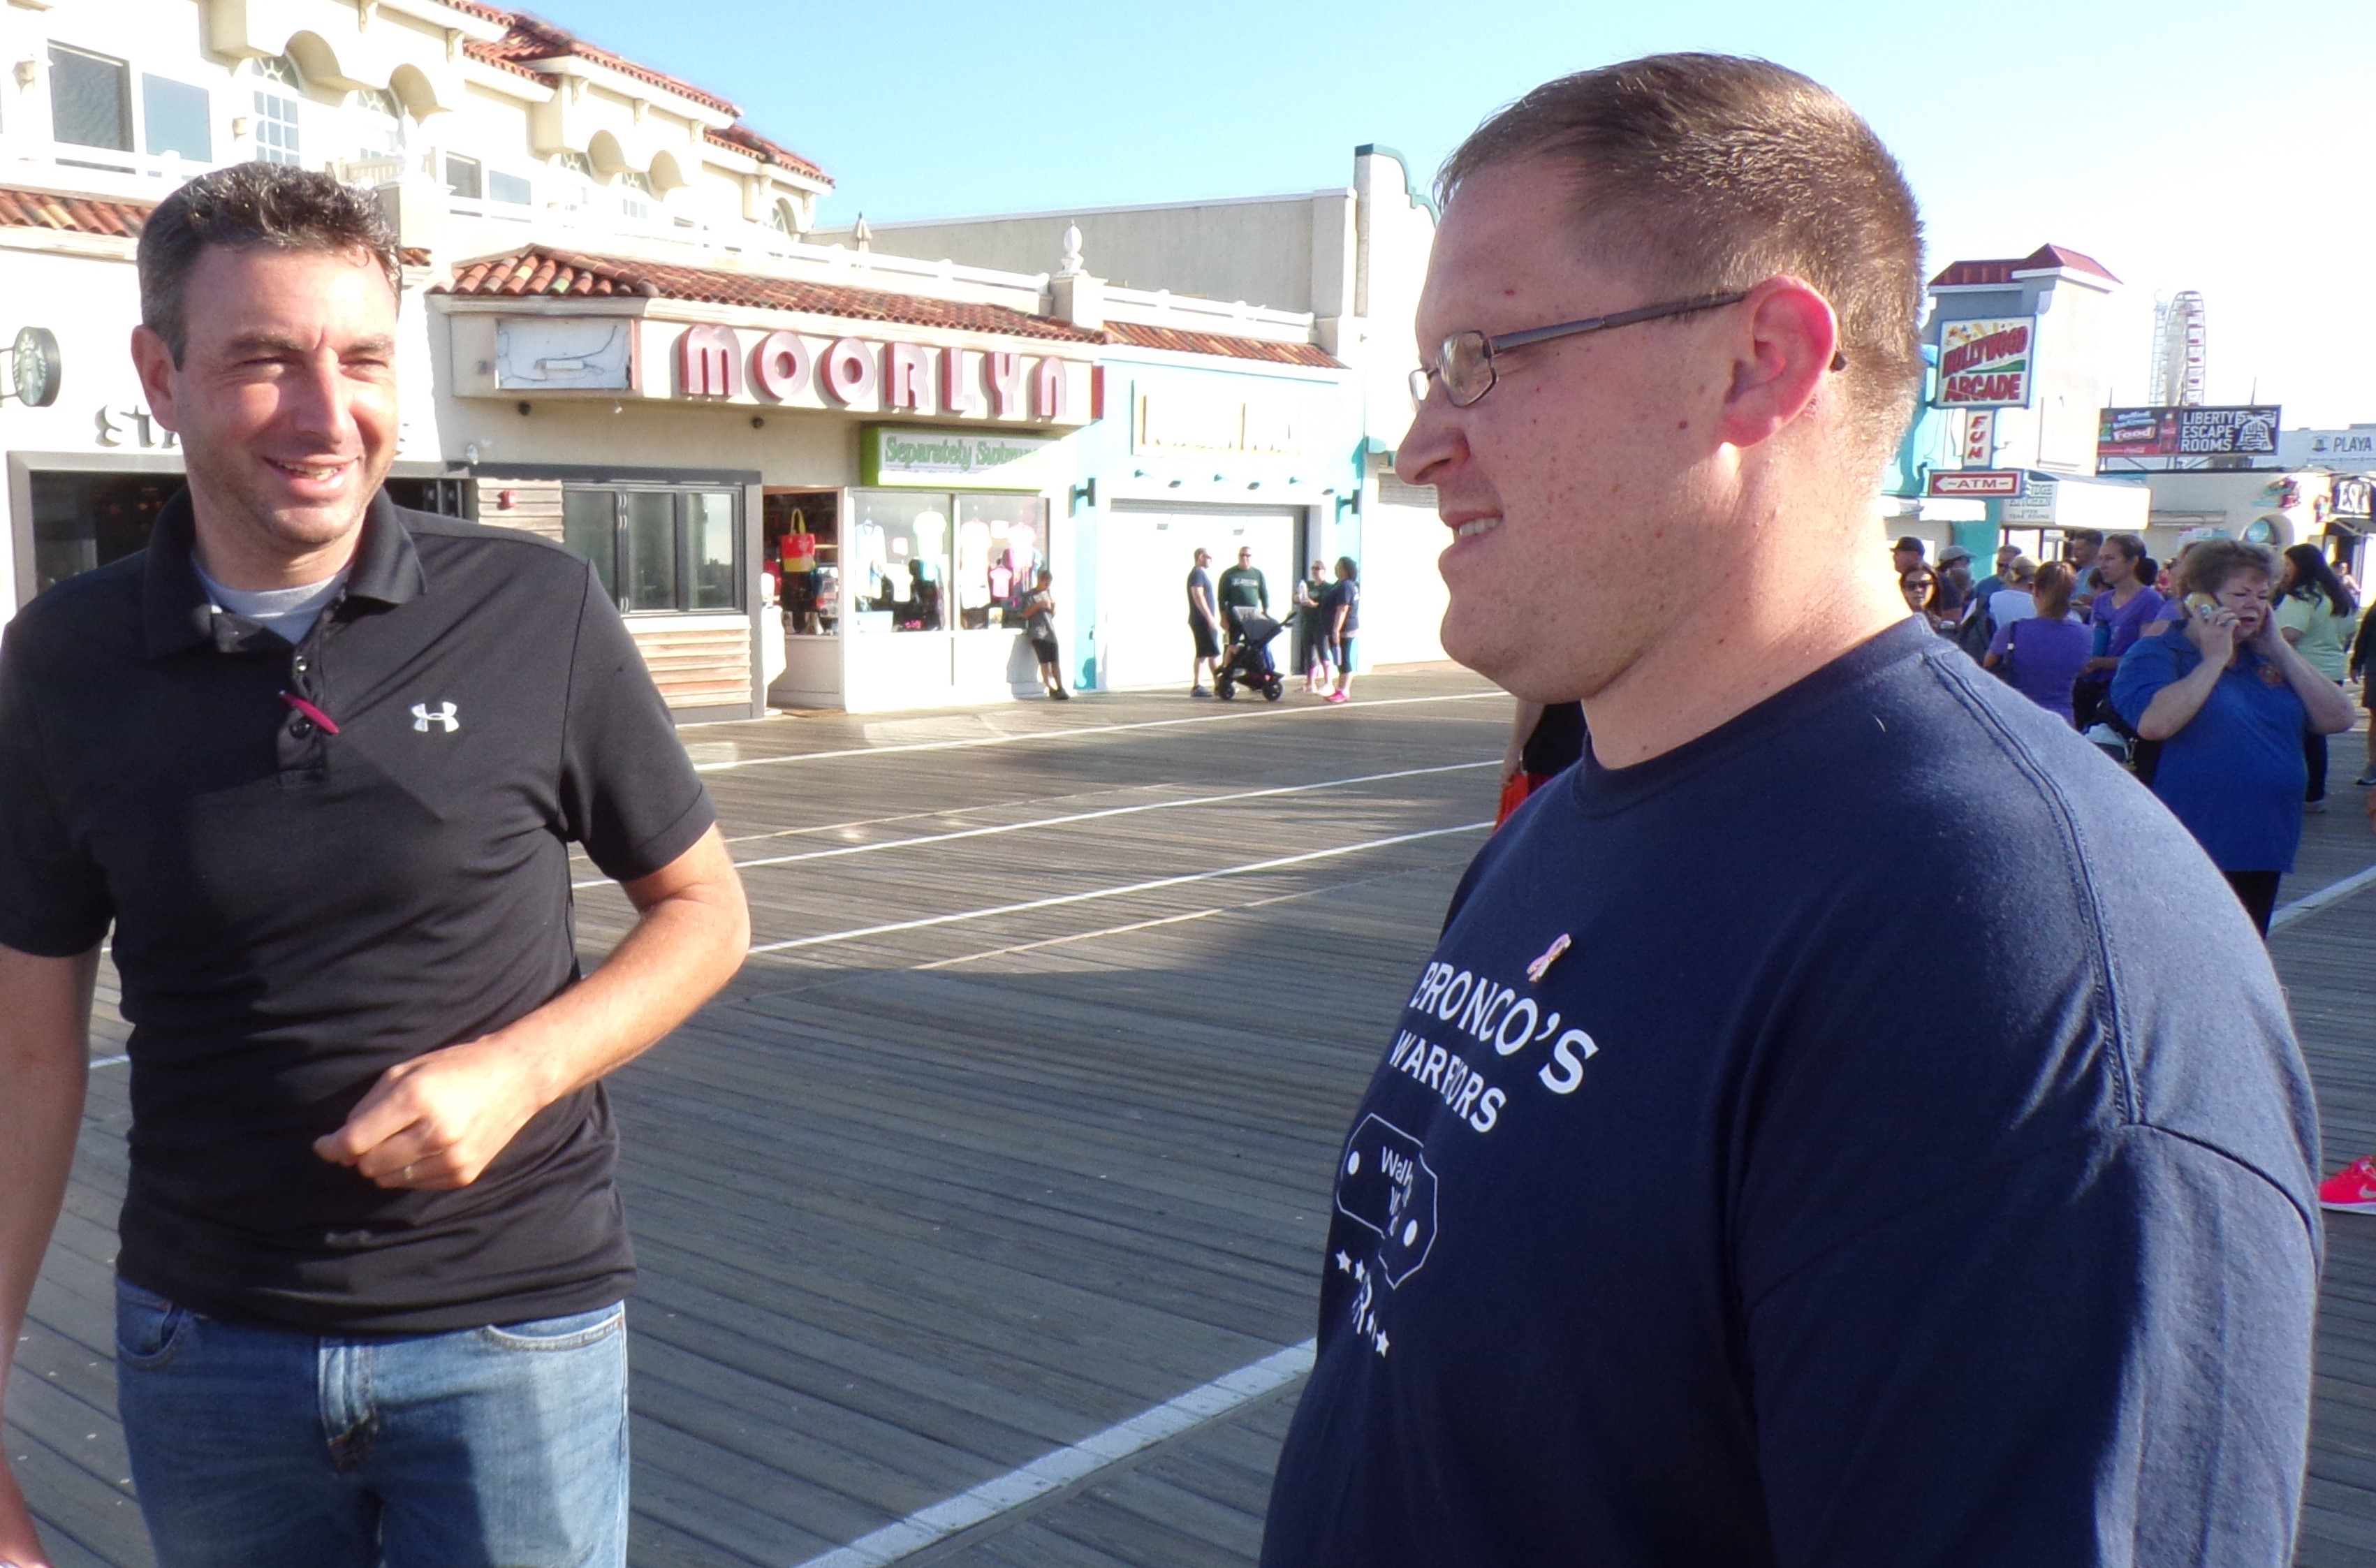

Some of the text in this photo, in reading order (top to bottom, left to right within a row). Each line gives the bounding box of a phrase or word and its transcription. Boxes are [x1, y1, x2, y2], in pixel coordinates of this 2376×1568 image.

[1942, 326, 2028, 379] HOLLYWOOD
[680, 323, 1066, 416] MOORLYN
[1943, 374, 2021, 402] ARCADE
[2183, 411, 2234, 425] LIBERTY
[2113, 426, 2153, 442] Food
[2182, 425, 2234, 439] ESCAPE
[2180, 439, 2233, 452] ROOMS
[2333, 437, 2372, 453] PLAYA
[885, 436, 972, 471] Separately
[1957, 479, 1997, 489] ATM
[1409, 961, 1599, 1094] BRONCO'S
